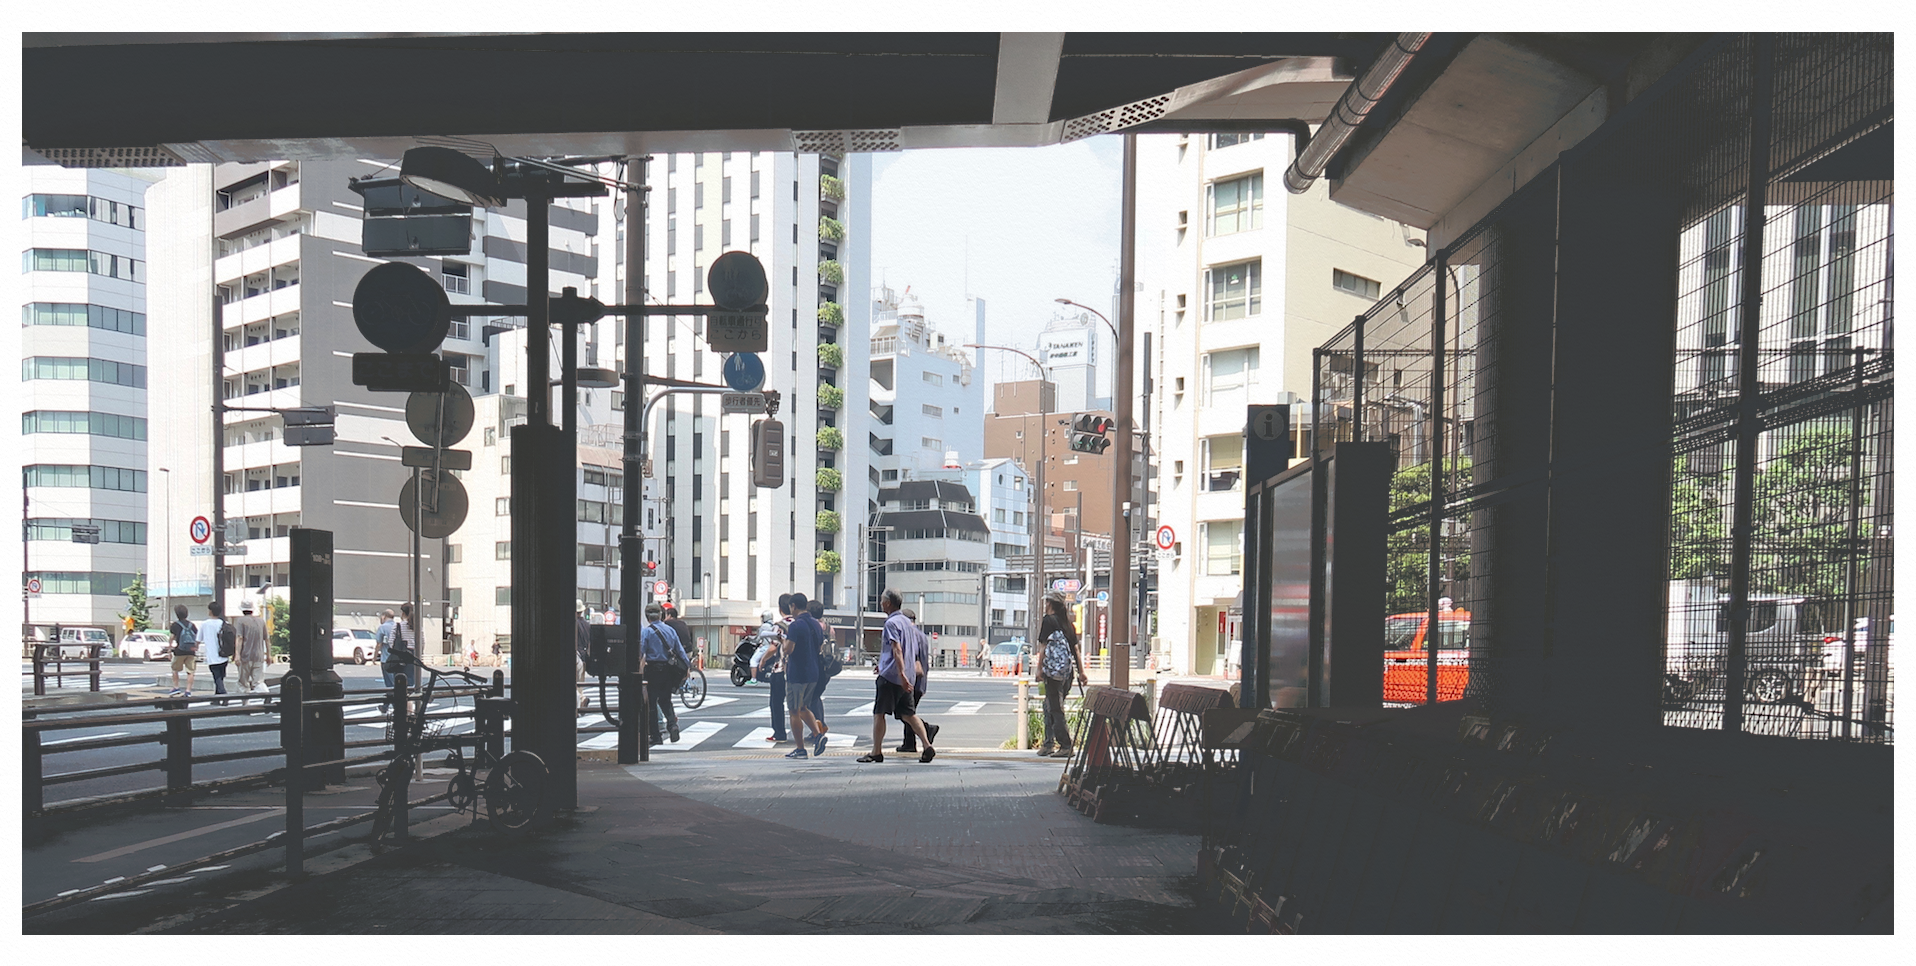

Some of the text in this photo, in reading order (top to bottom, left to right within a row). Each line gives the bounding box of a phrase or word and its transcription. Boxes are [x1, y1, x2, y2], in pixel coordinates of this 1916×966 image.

[710, 315, 763, 327] 自転車通行可
[710, 329, 762, 341] ここから
[1053, 341, 1083, 349] TANAKEN
[357, 361, 434, 378] ここまで
[725, 396, 761, 406] 歩行者優先
